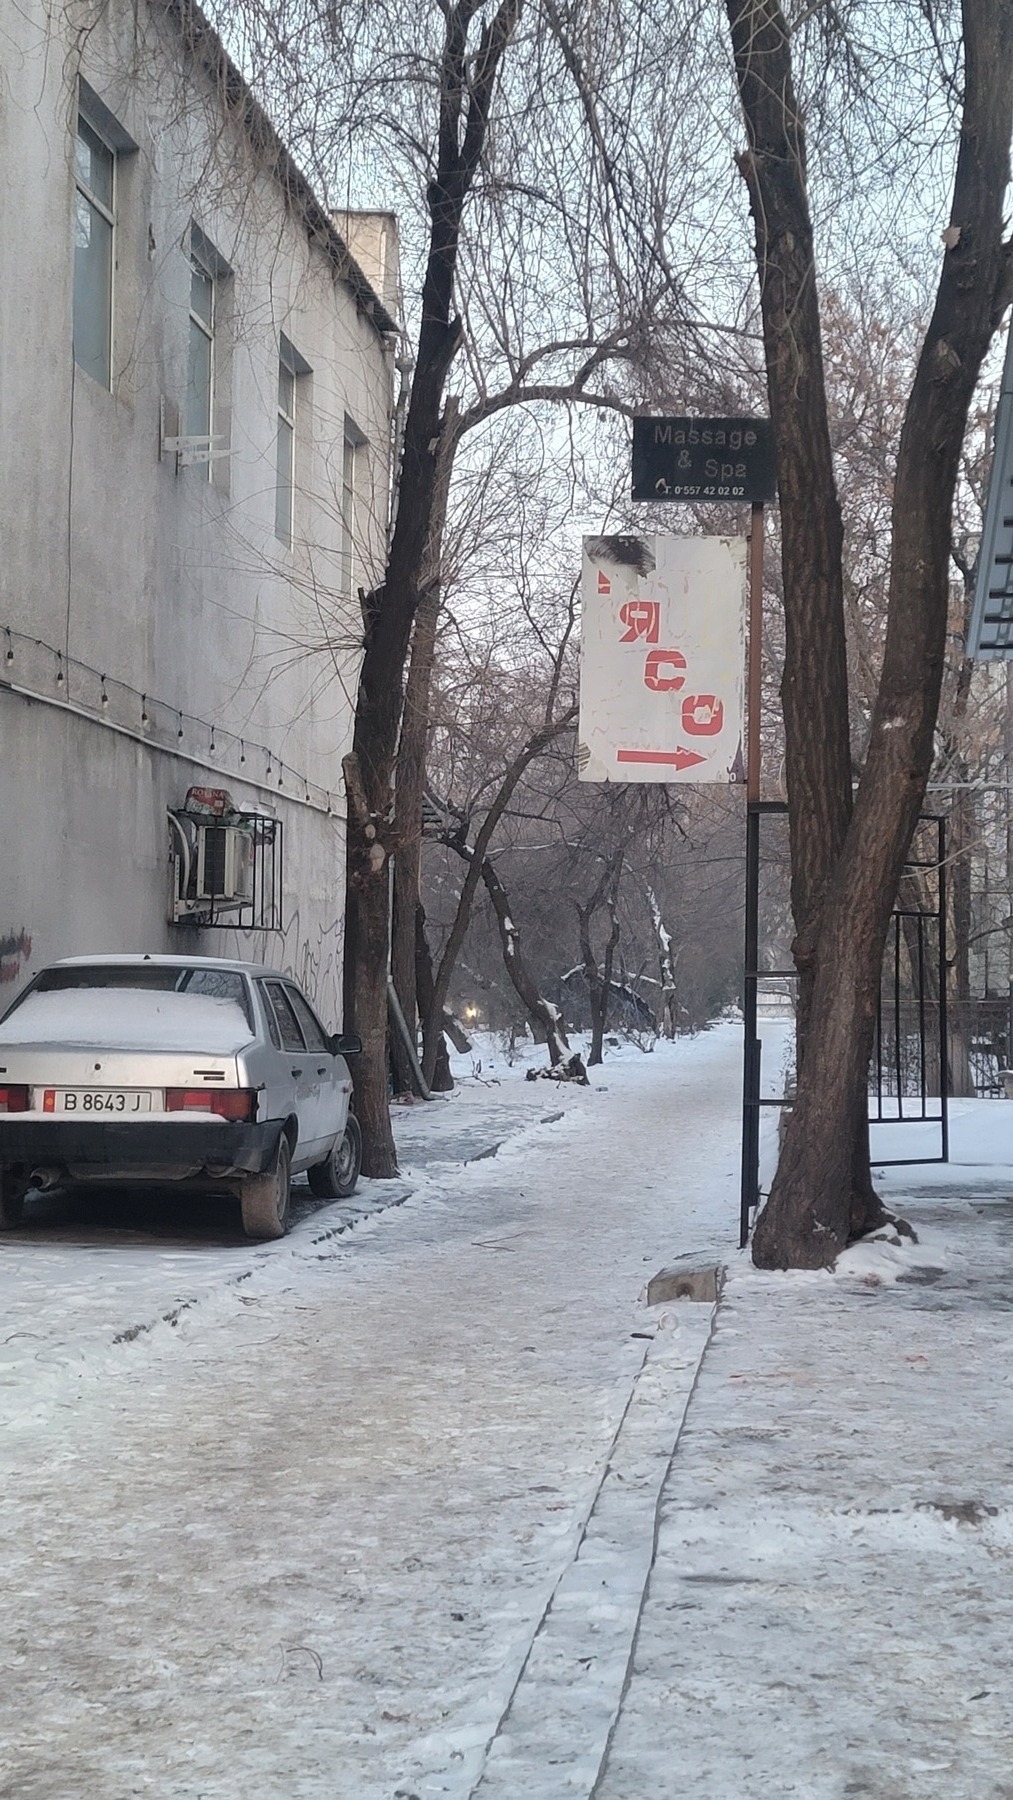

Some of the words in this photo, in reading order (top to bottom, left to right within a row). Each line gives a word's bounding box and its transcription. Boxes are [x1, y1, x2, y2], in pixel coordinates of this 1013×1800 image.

[654, 425, 758, 450] Massage
[677, 449, 693, 468] &
[704, 459, 747, 481] Spa
[703, 486, 716, 496] 42
[717, 486, 730, 496] 02
[732, 486, 745, 496] 02
[64, 1093, 77, 1111] B
[82, 1094, 126, 1111] 8643
[131, 1094, 141, 1111] J
